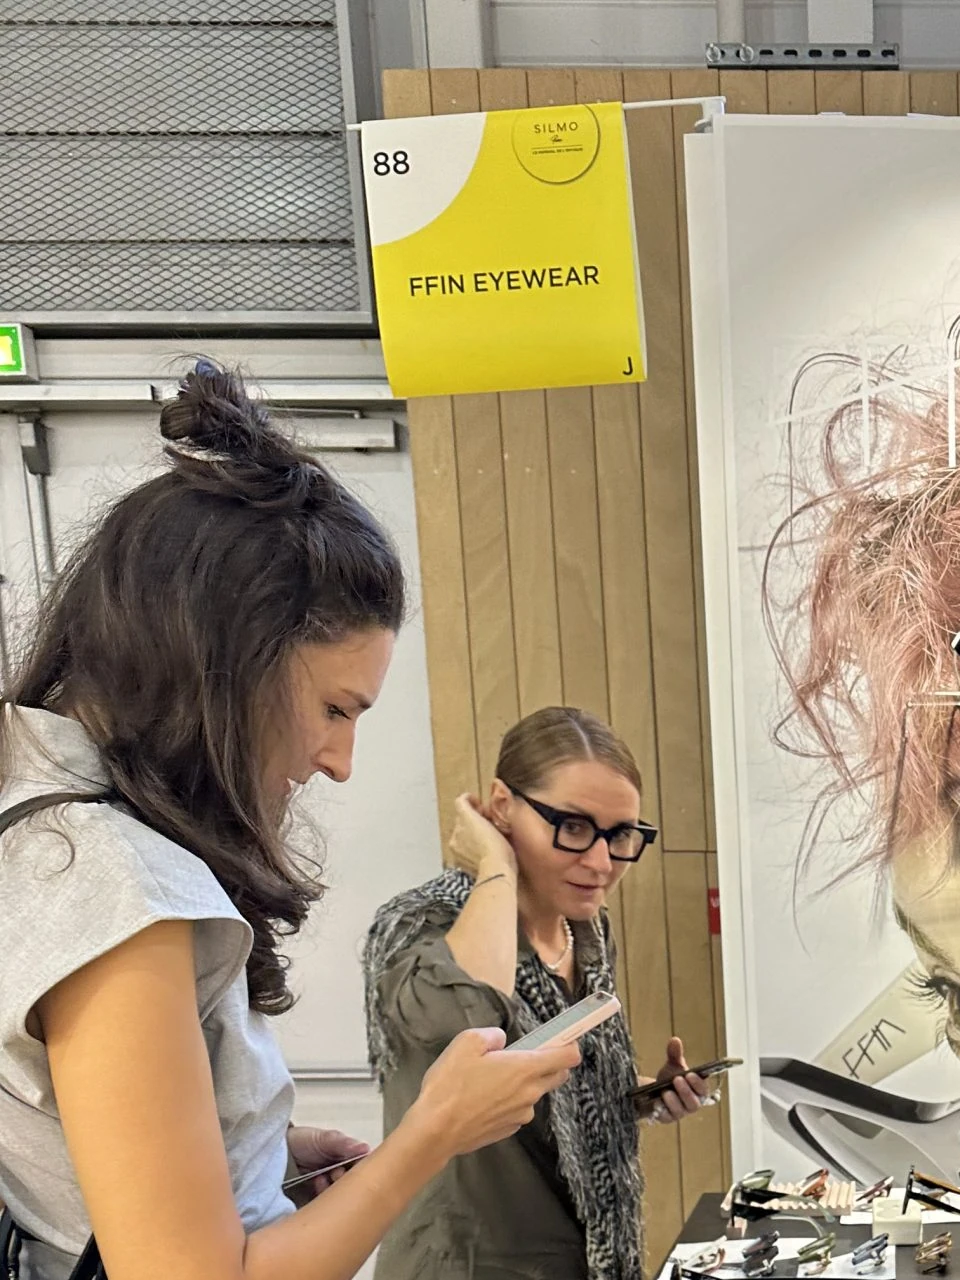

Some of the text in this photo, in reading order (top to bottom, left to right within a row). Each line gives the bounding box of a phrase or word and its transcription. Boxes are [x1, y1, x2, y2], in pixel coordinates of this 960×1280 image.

[534, 121, 579, 134] SILMO
[373, 150, 410, 176] 88
[409, 264, 600, 297] FFIN EYEWEAR
[622, 356, 634, 376] J
